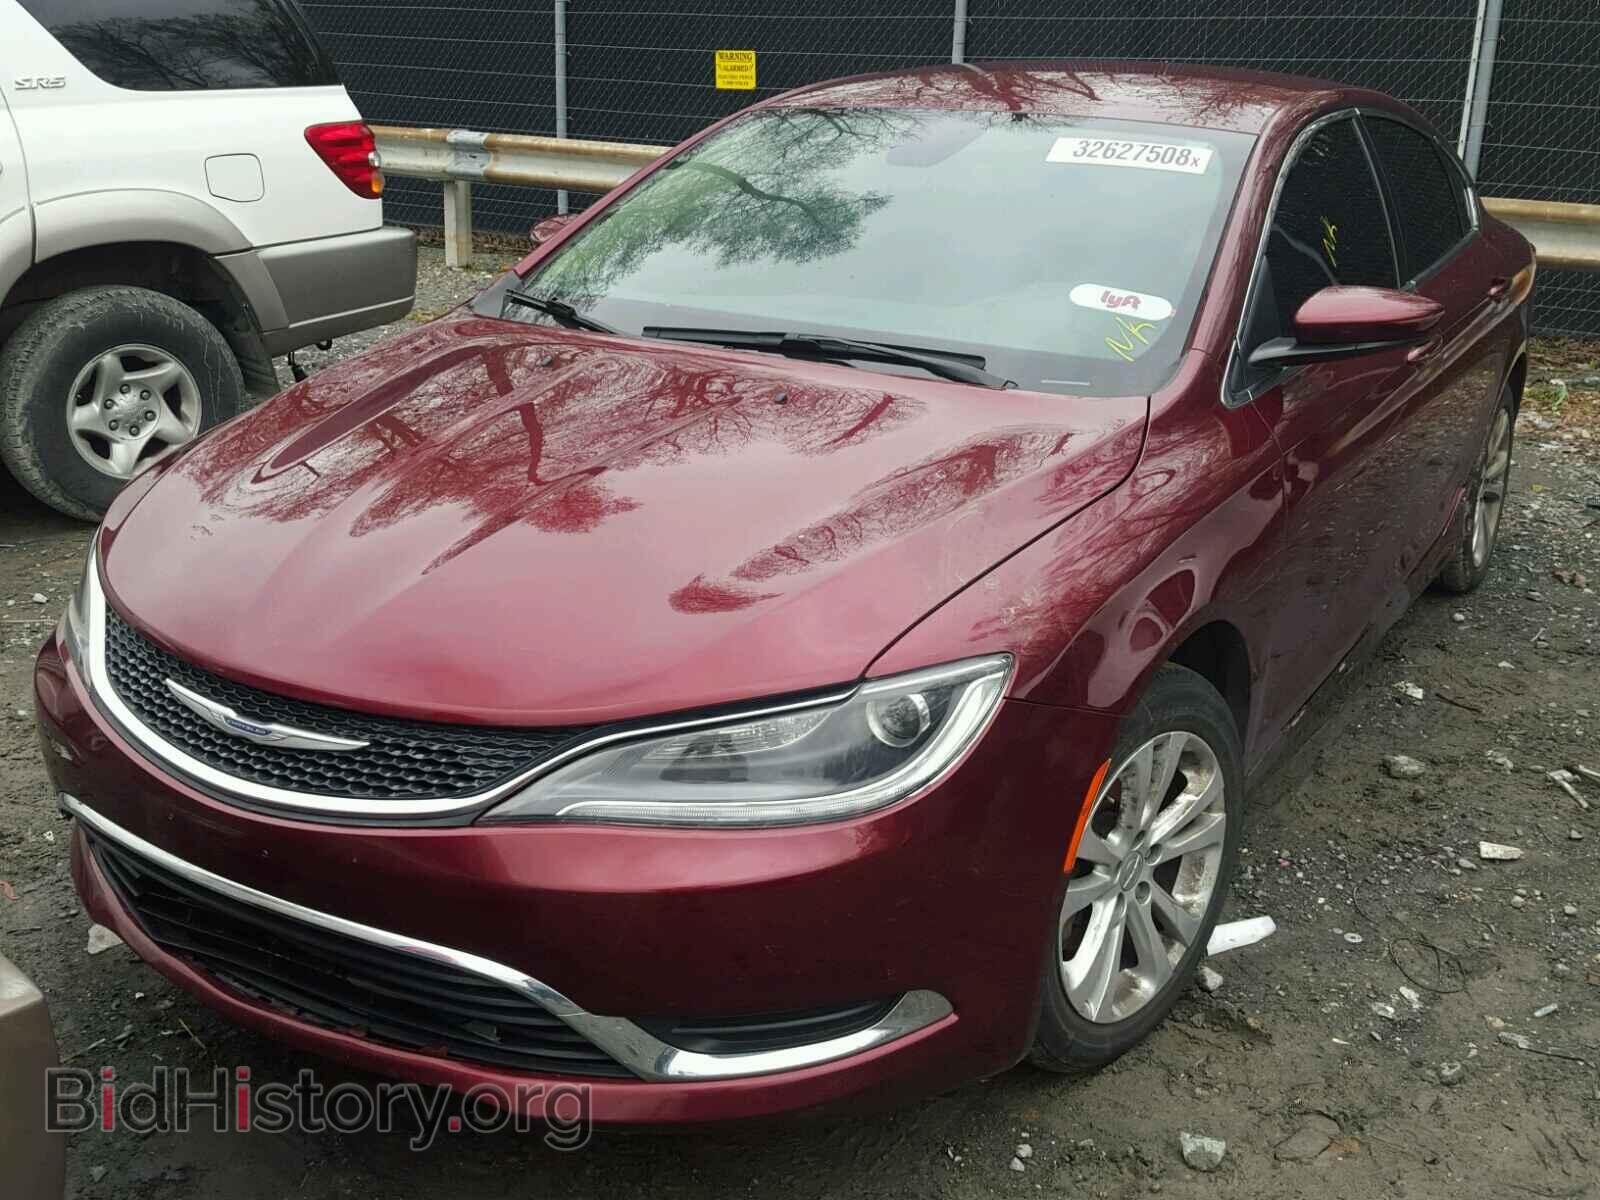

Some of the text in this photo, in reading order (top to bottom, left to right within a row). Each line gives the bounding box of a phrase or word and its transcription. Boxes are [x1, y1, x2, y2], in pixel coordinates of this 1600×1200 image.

[718, 52, 753, 61] WARNING
[15, 76, 66, 90] SR5
[1100, 290, 1142, 309] lyft
